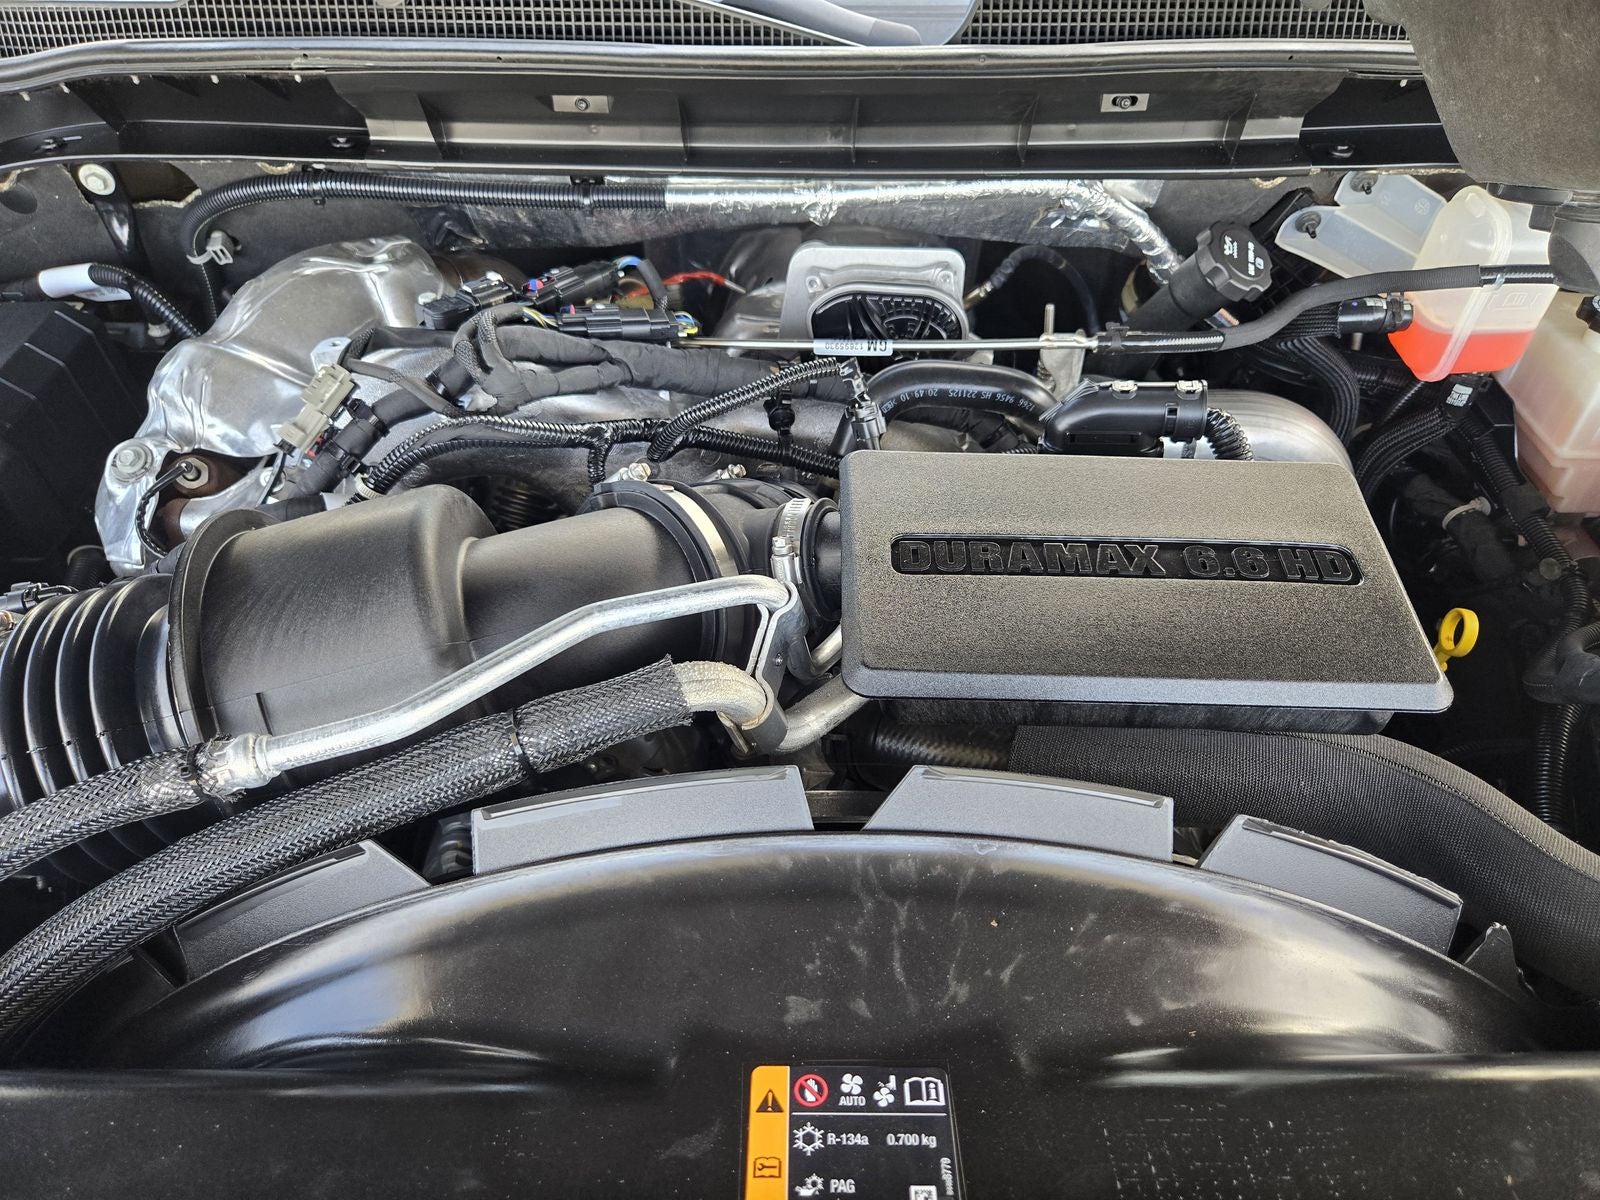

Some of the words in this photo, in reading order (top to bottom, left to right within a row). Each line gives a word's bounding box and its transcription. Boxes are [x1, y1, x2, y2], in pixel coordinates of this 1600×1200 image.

[867, 340, 888, 352] GM
[948, 389, 976, 399] 221125
[980, 391, 992, 399] HS
[995, 393, 1014, 404] 9456
[898, 541, 1166, 575] DURAMAX
[1183, 545, 1270, 578] 6.6
[1278, 549, 1356, 582] HD
[838, 1095, 866, 1107] AUTO
[826, 1133, 870, 1145] R-134a
[886, 1133, 920, 1146] 0.700
[921, 1133, 937, 1148] kg
[829, 1179, 856, 1193] PAG
